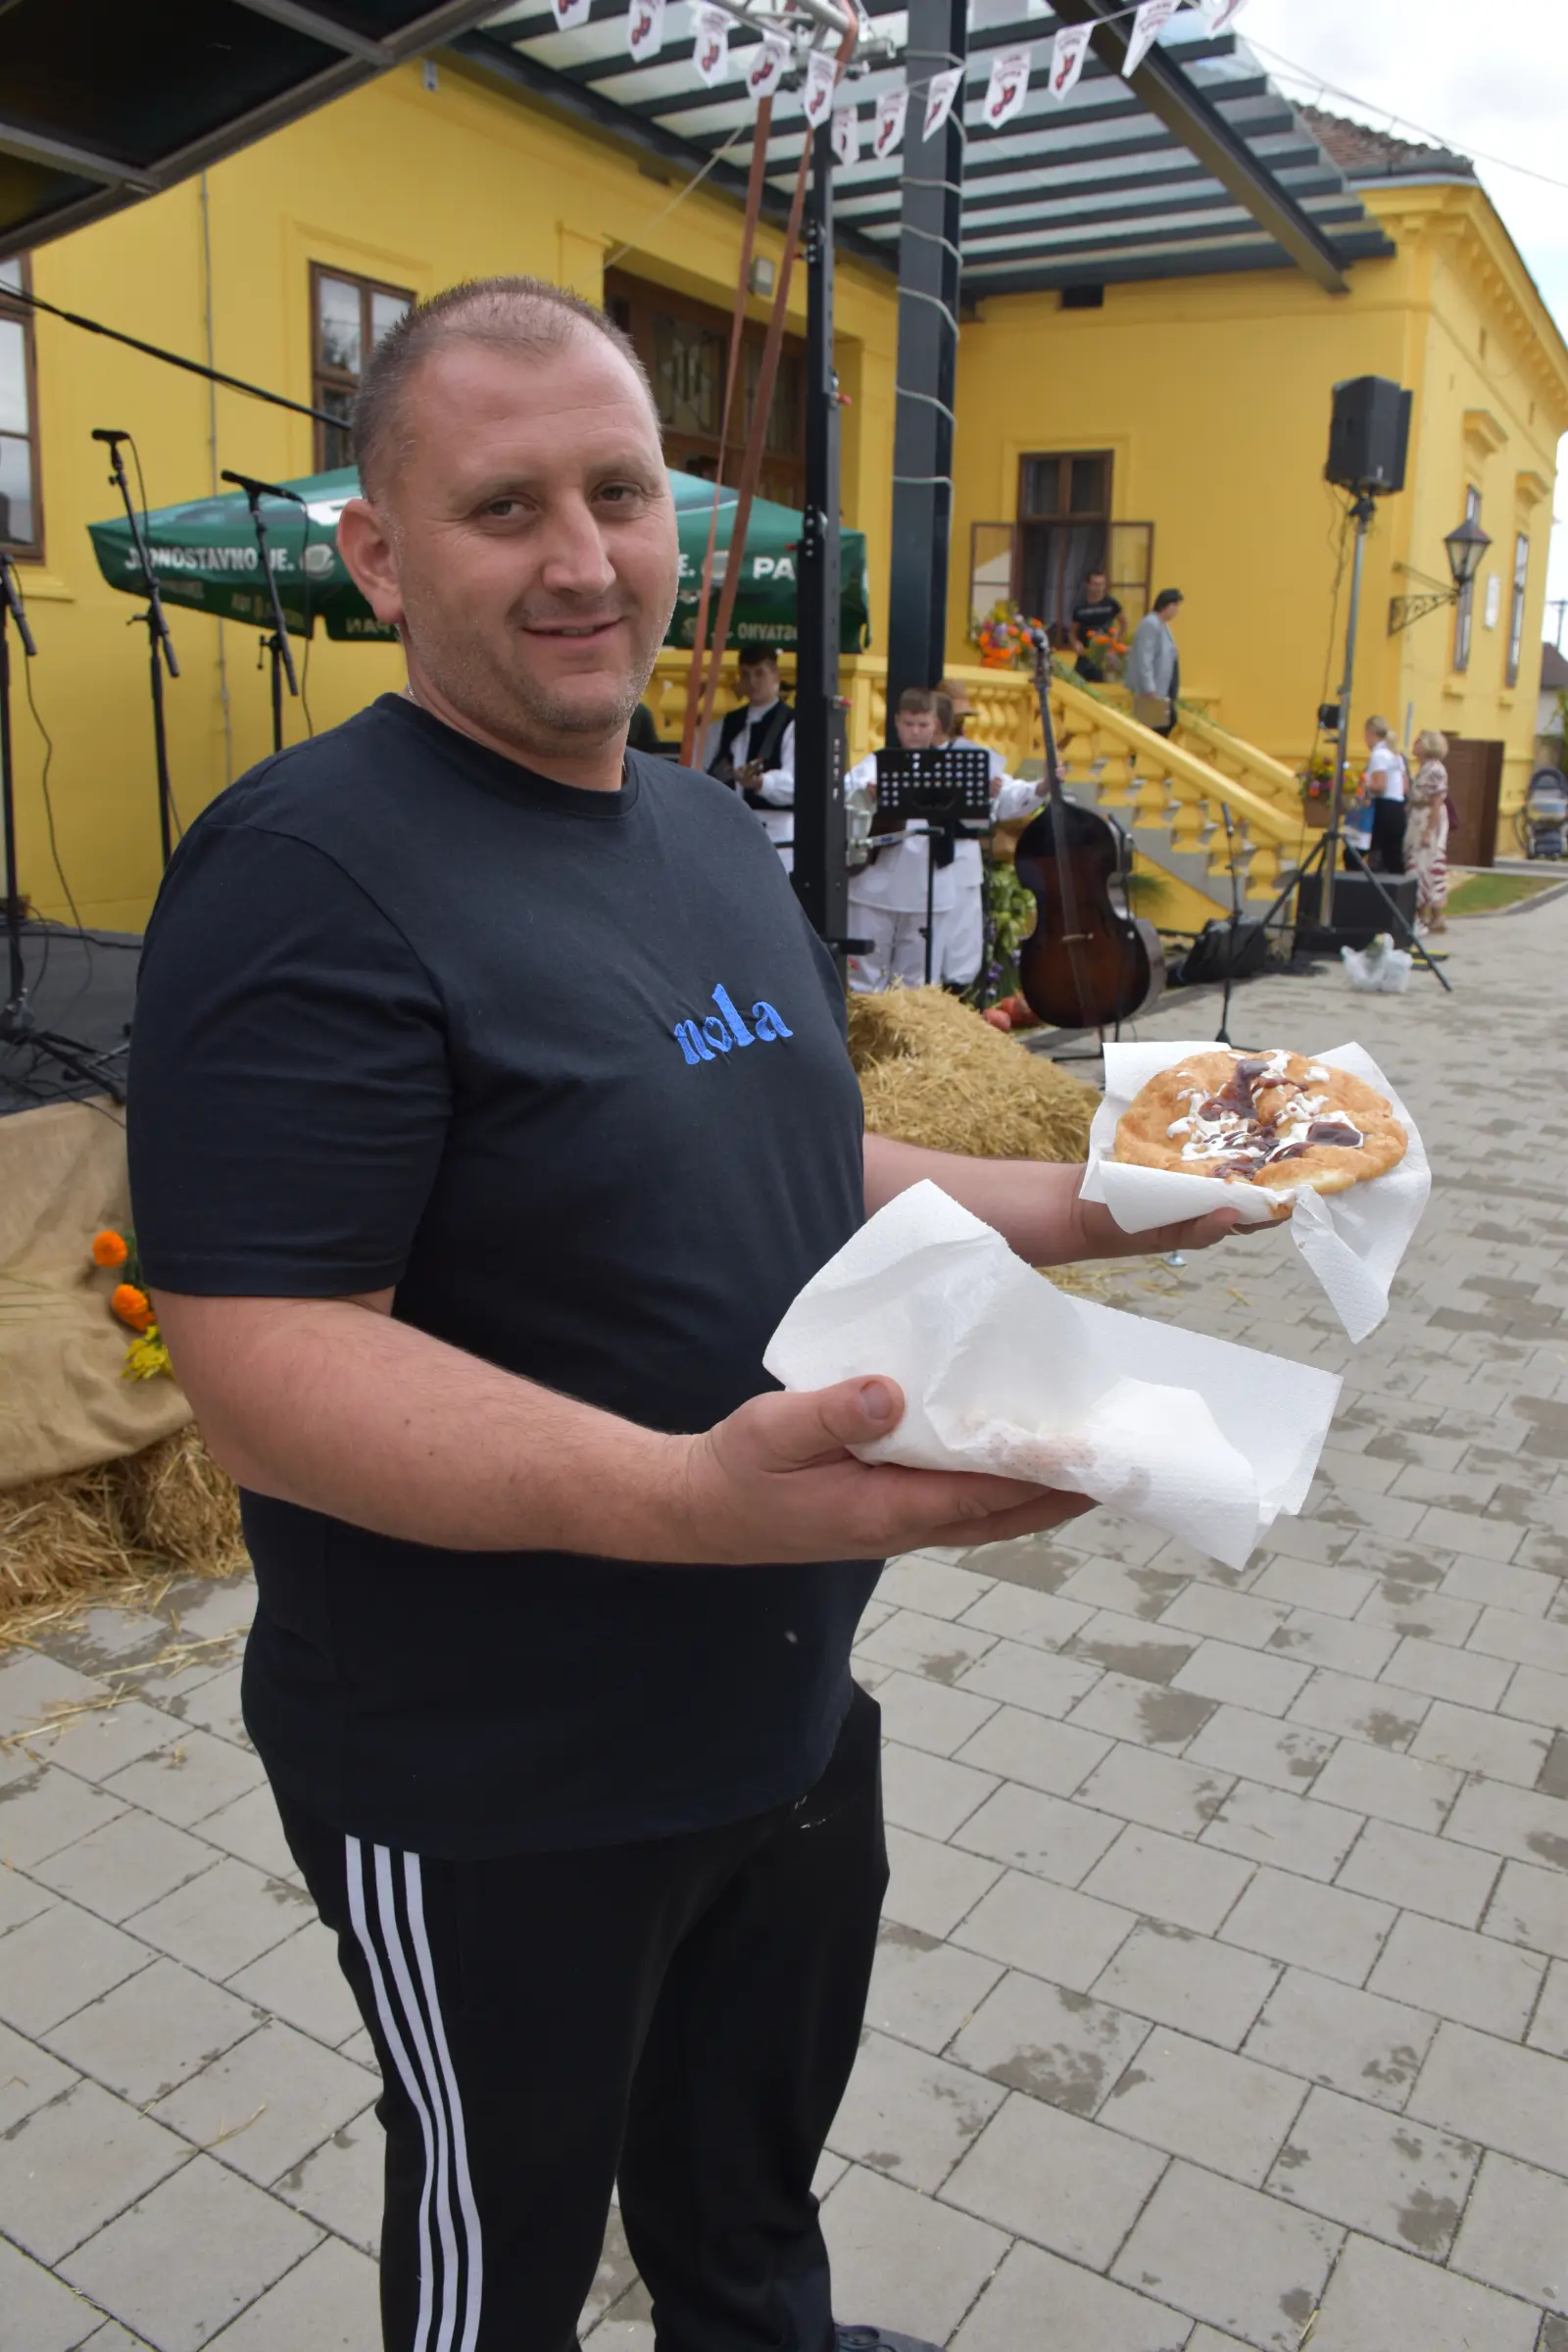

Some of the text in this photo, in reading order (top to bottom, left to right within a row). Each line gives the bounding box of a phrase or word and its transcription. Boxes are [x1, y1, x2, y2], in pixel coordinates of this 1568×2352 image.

[124, 546, 259, 570] JDNOSTAVNO
[677, 553, 696, 576] E.
[753, 557, 797, 580] PA
[673, 983, 794, 1065] nola
